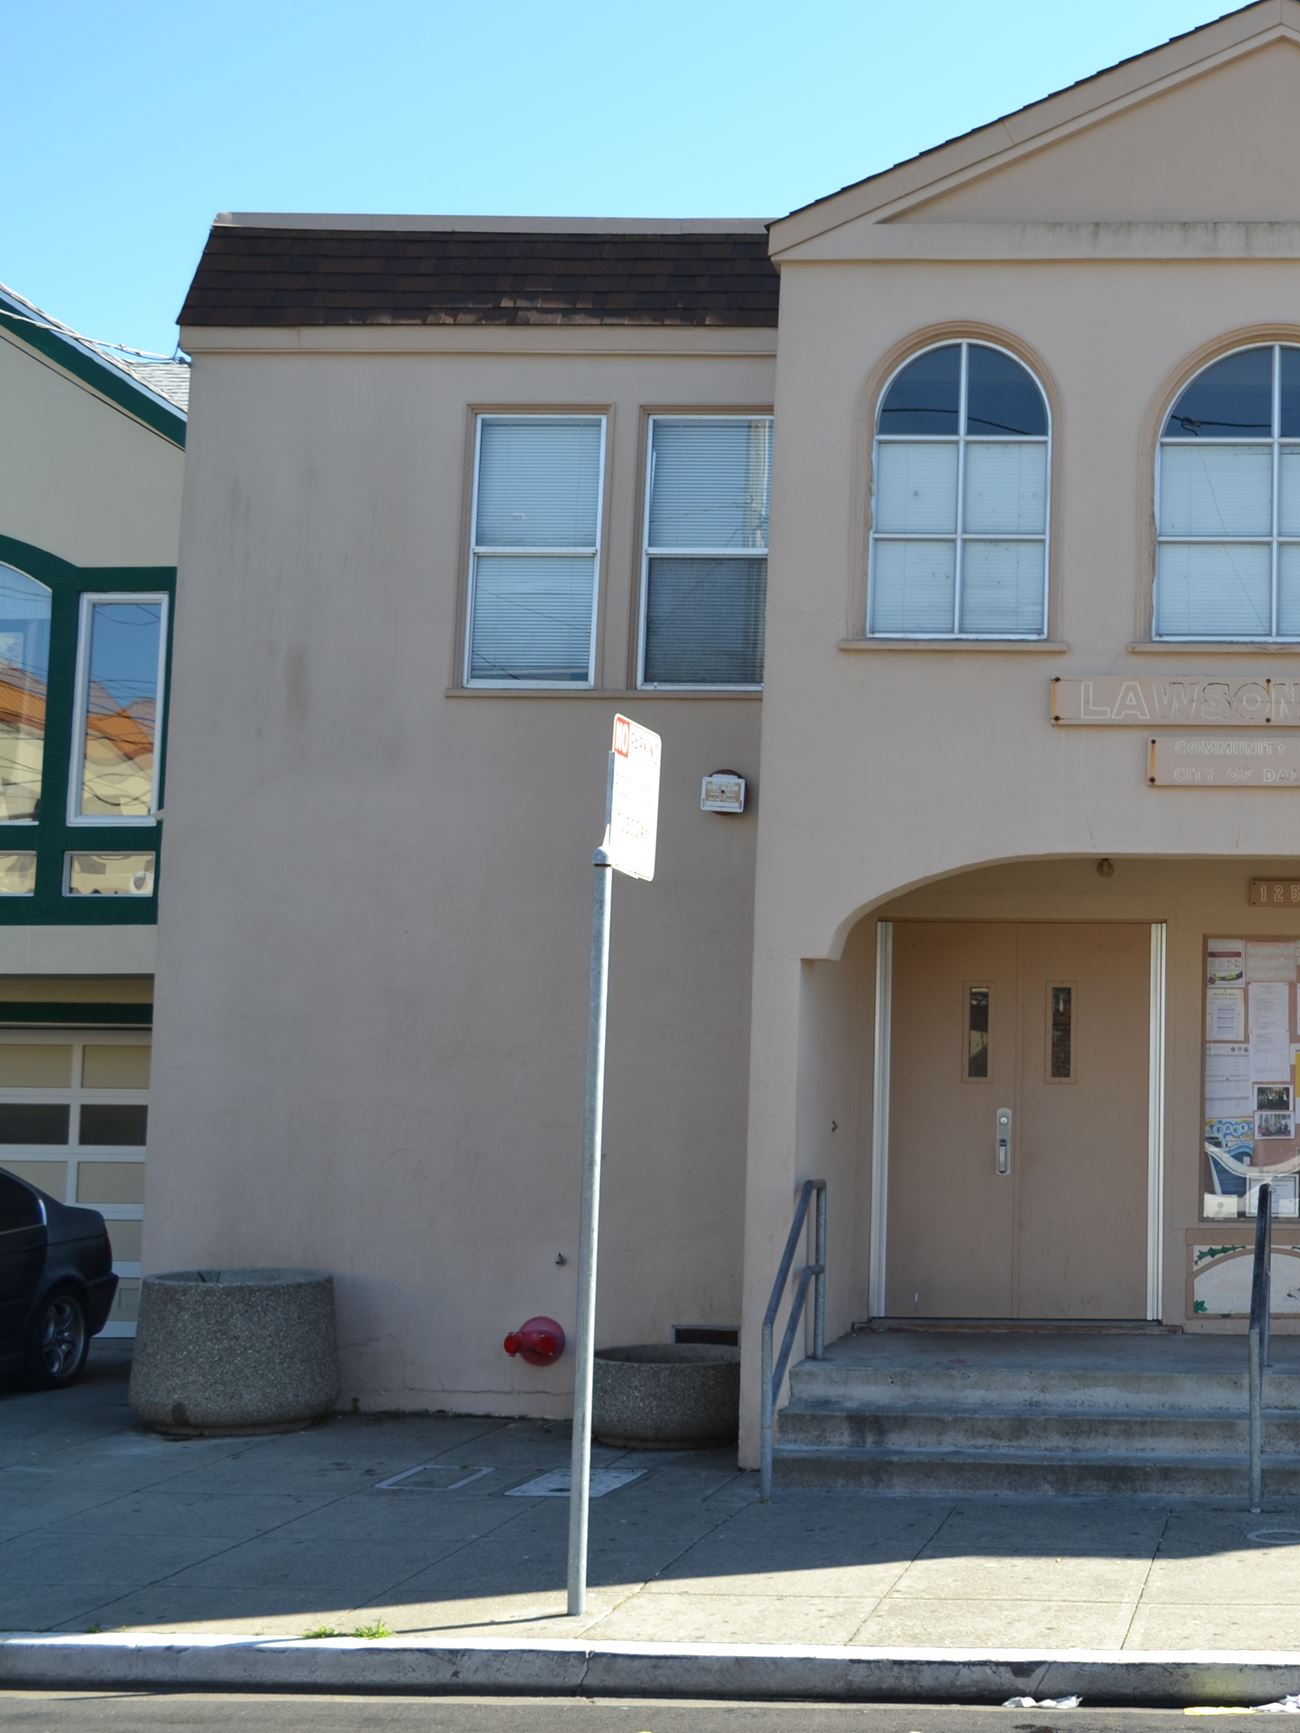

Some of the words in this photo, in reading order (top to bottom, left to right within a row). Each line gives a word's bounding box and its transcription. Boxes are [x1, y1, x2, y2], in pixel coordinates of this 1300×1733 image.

[1174, 740, 1287, 756] COMMUNITY
[1173, 767, 1216, 783] CITY
[1226, 768, 1253, 783] OF
[1260, 884, 1300, 903] 125
